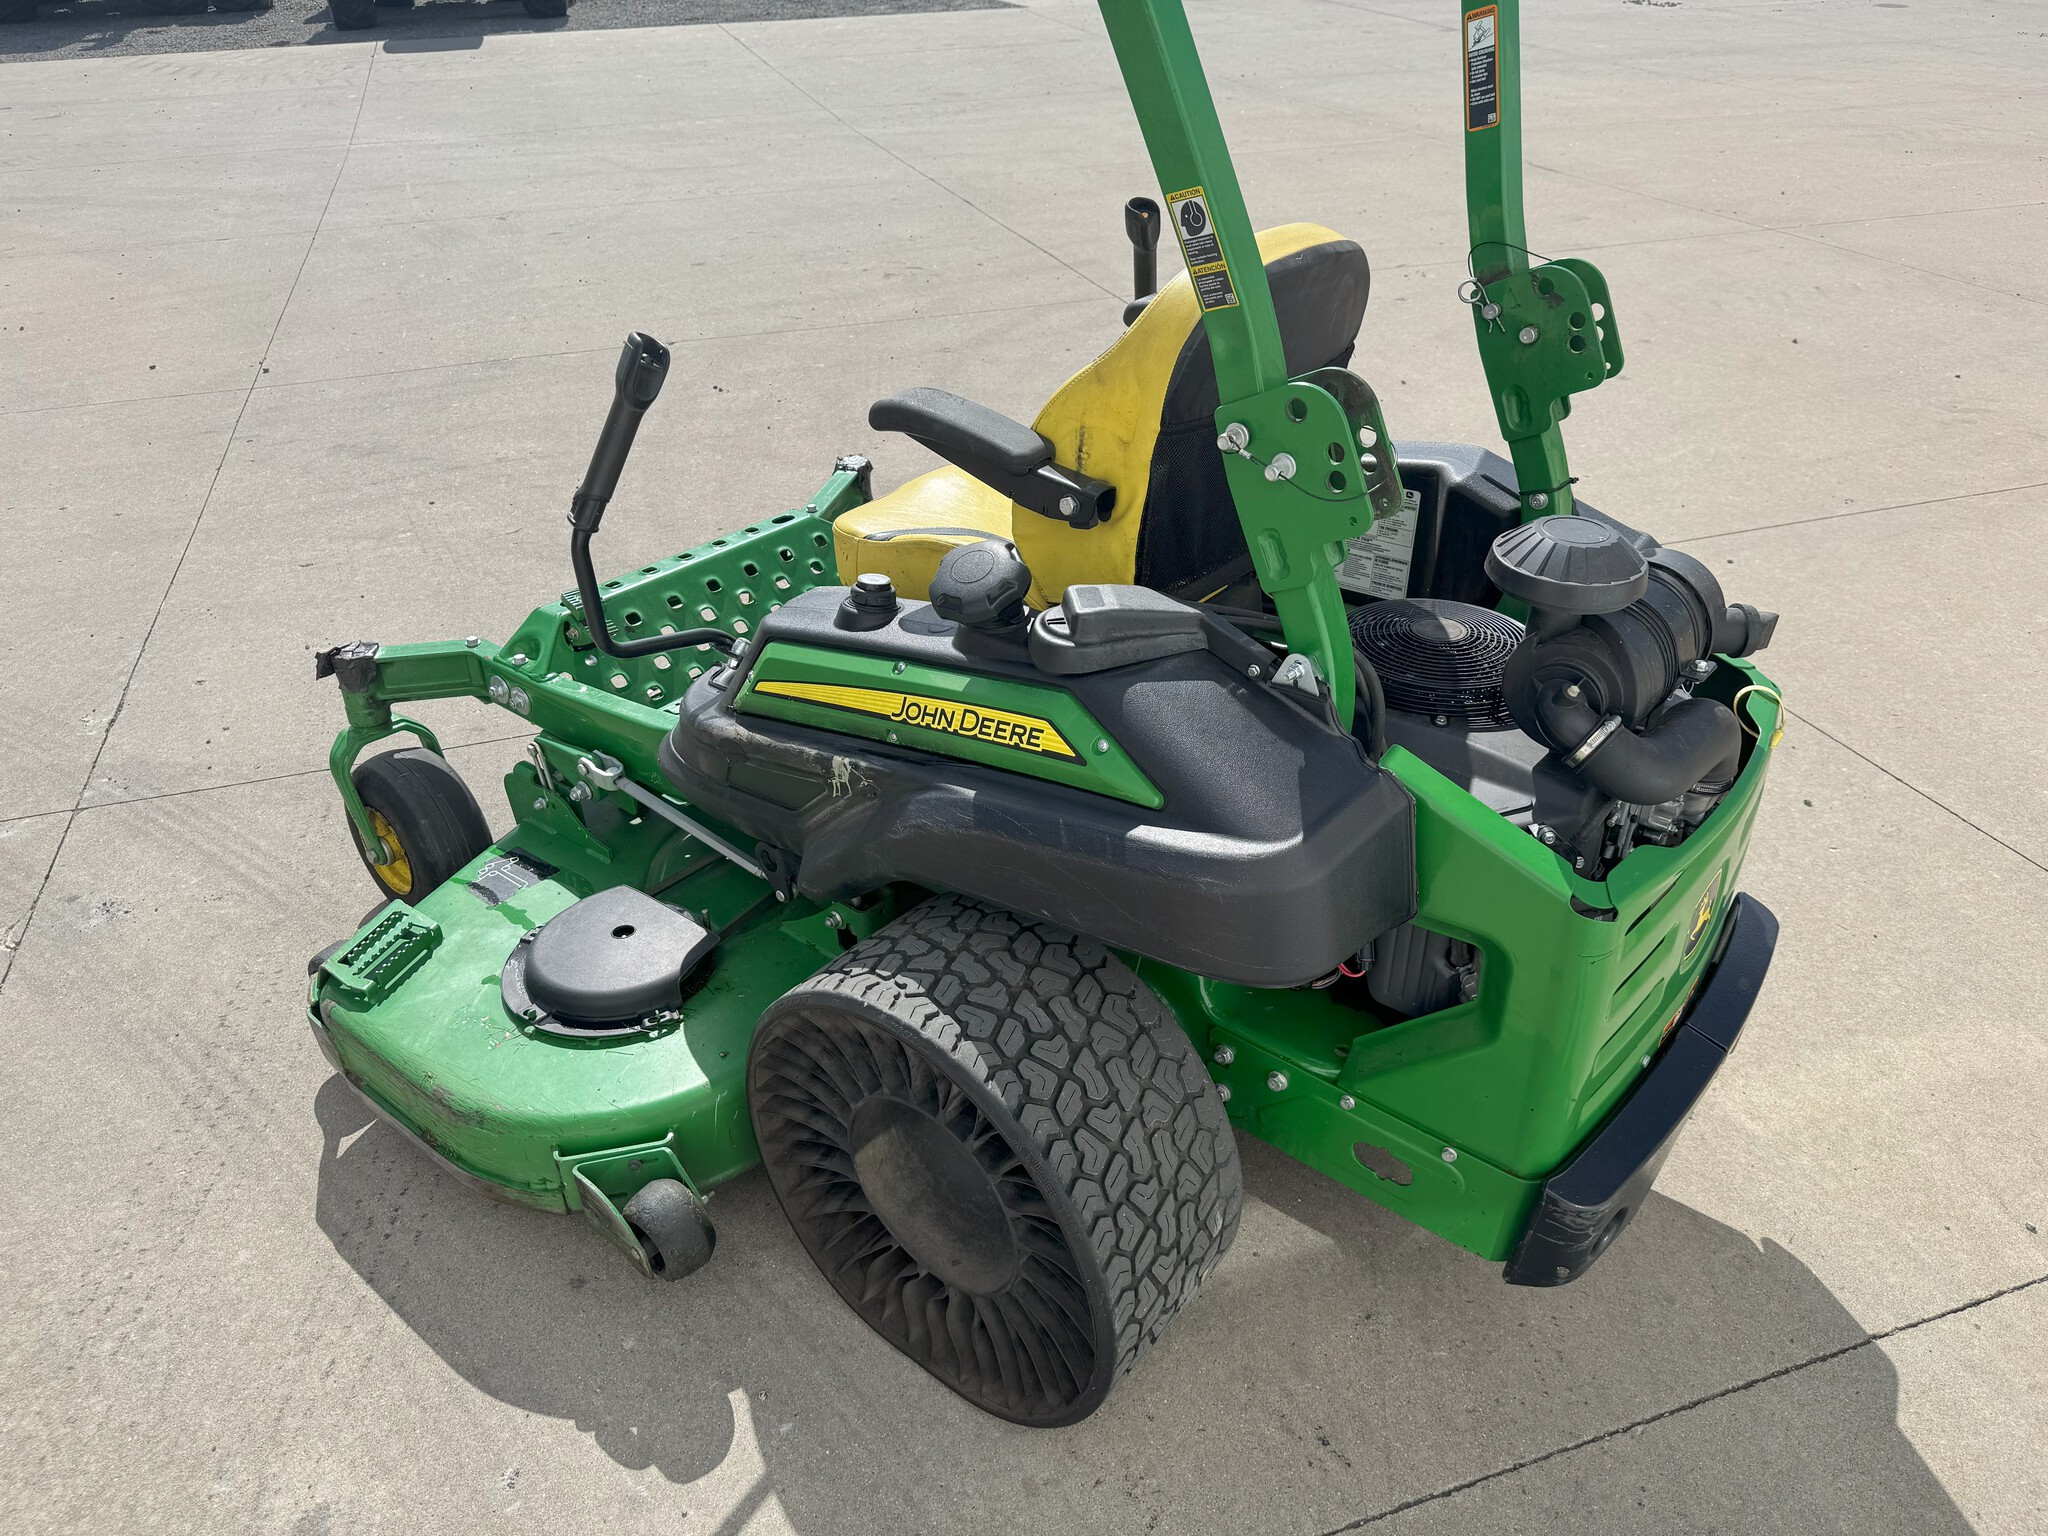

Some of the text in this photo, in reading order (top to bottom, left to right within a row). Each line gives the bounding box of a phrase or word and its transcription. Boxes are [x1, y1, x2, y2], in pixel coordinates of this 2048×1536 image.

[1471, 6, 1495, 18] WARNING
[1175, 188, 1201, 200] CAUTION
[1198, 263, 1226, 274] ATENCIÓN
[890, 696, 1045, 749] JOHN DEERE
